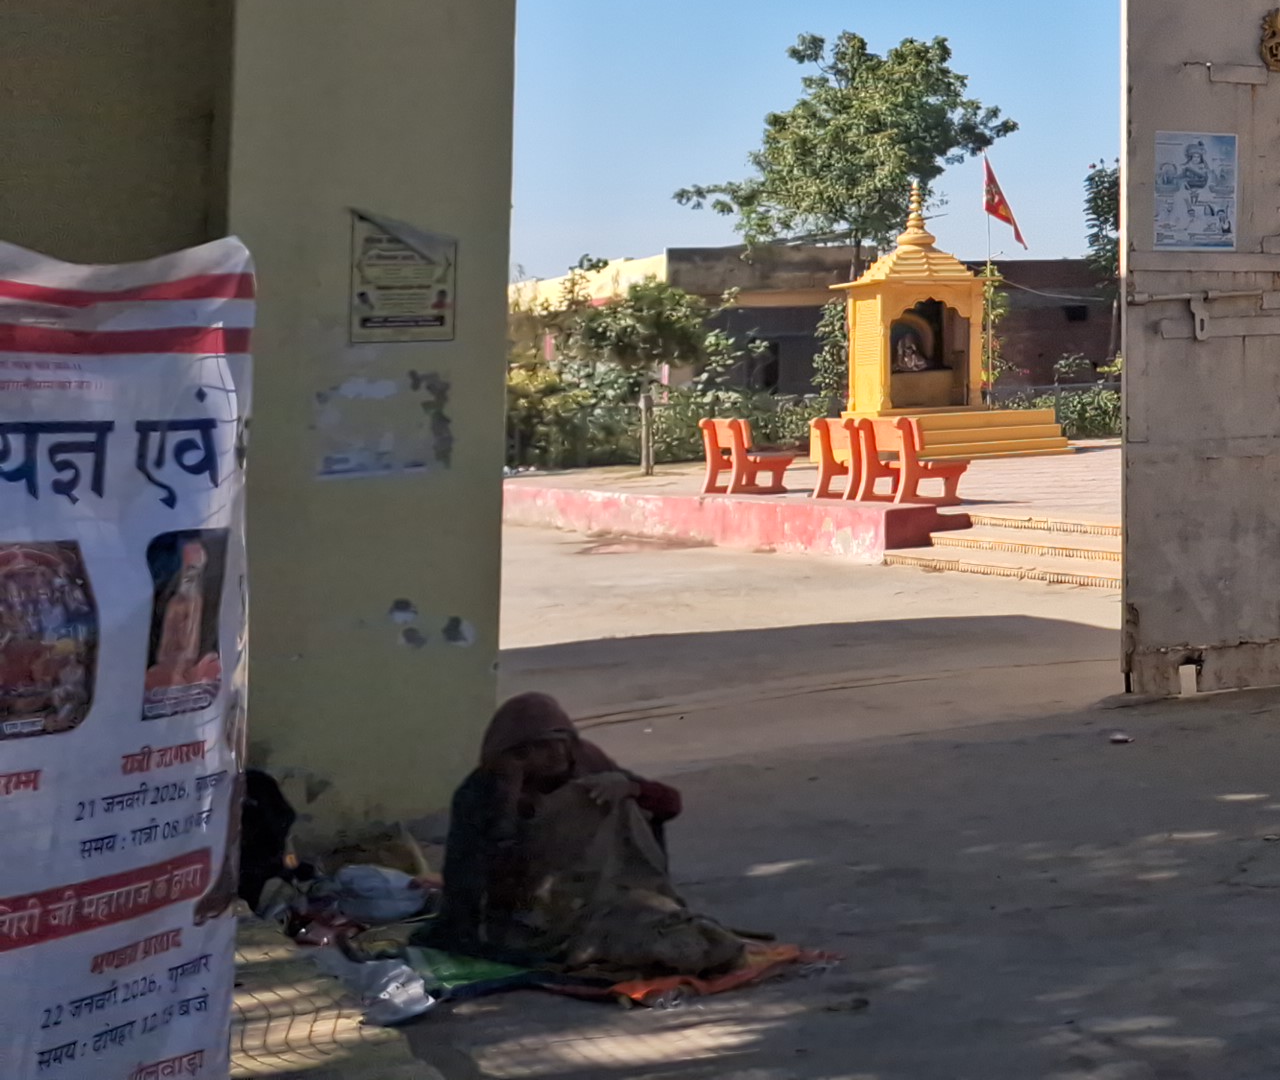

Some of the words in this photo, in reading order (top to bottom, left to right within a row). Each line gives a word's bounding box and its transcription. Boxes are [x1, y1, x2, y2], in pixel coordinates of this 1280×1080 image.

[135, 389, 219, 509] एवं
[75, 799, 96, 822] 21
[101, 782, 149, 814] जनवरी
[48, 890, 77, 927] जी
[82, 881, 151, 921] महाराज
[41, 1004, 64, 1030] 22
[36, 1039, 78, 1070] समय
